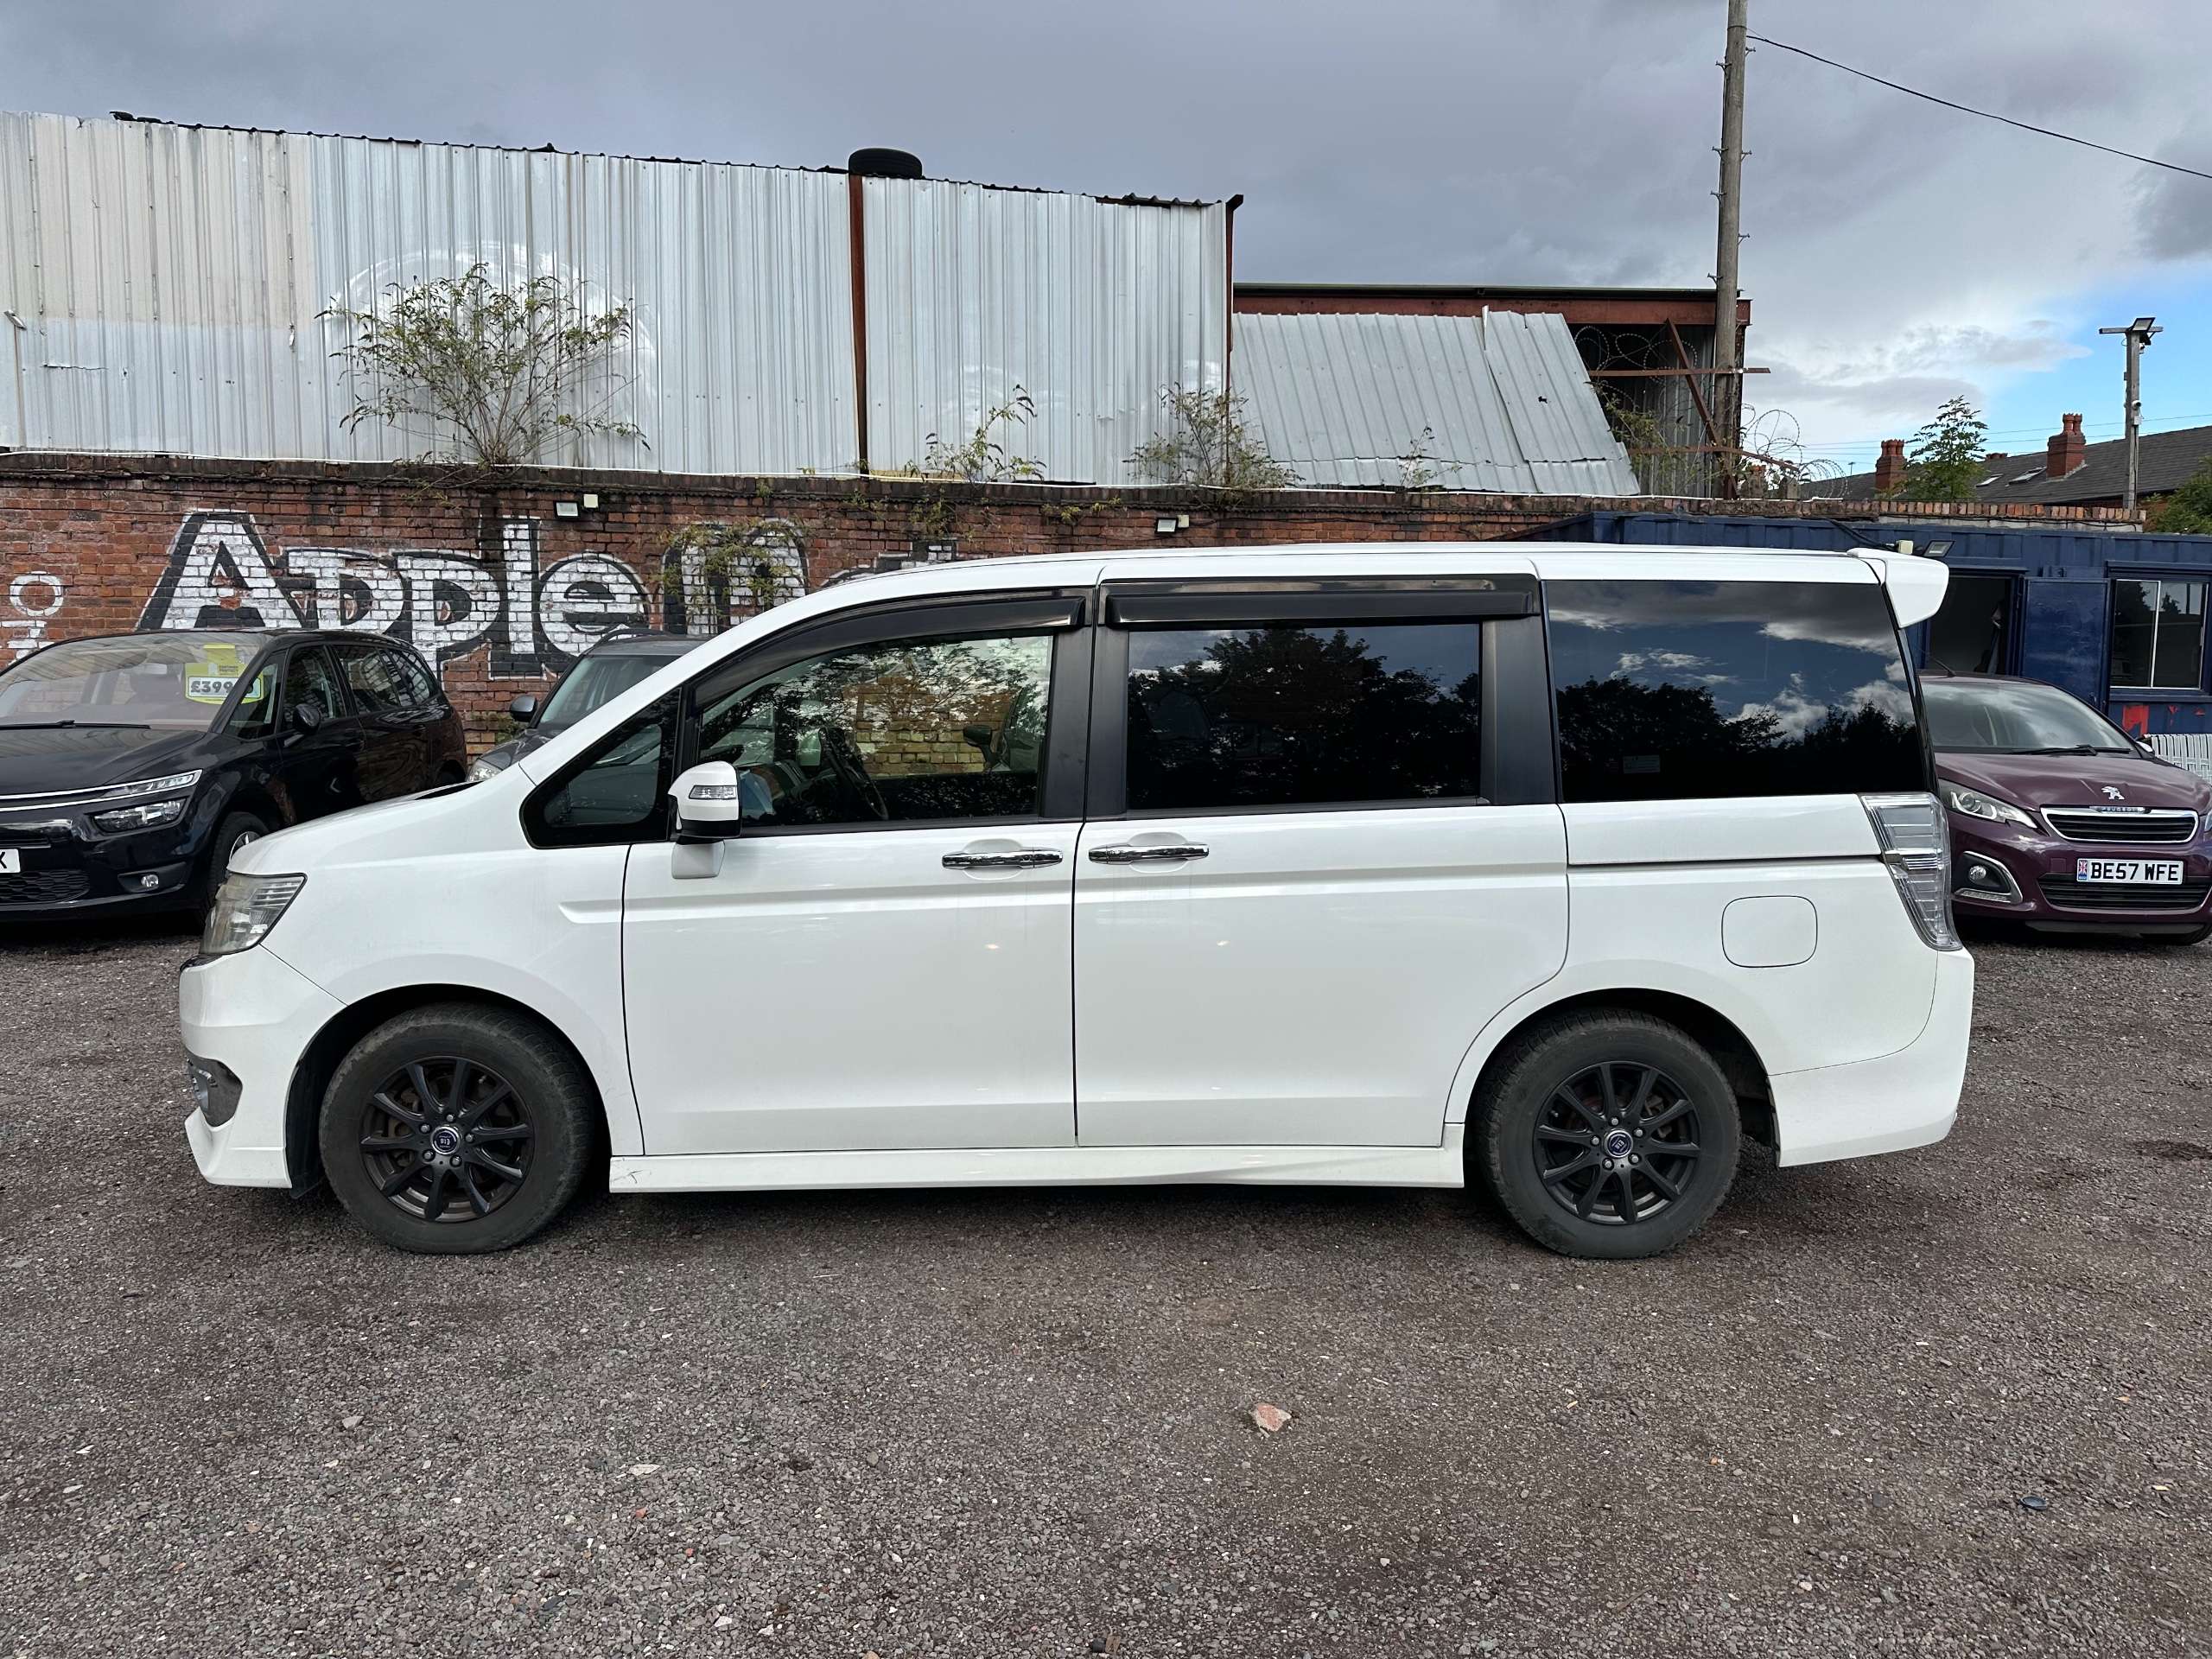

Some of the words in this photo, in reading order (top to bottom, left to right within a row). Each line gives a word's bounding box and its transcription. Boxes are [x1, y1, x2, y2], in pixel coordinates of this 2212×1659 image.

[136, 508, 654, 681] Apple
[2091, 862, 2139, 880] BE57
[2145, 864, 2179, 880] WFE
